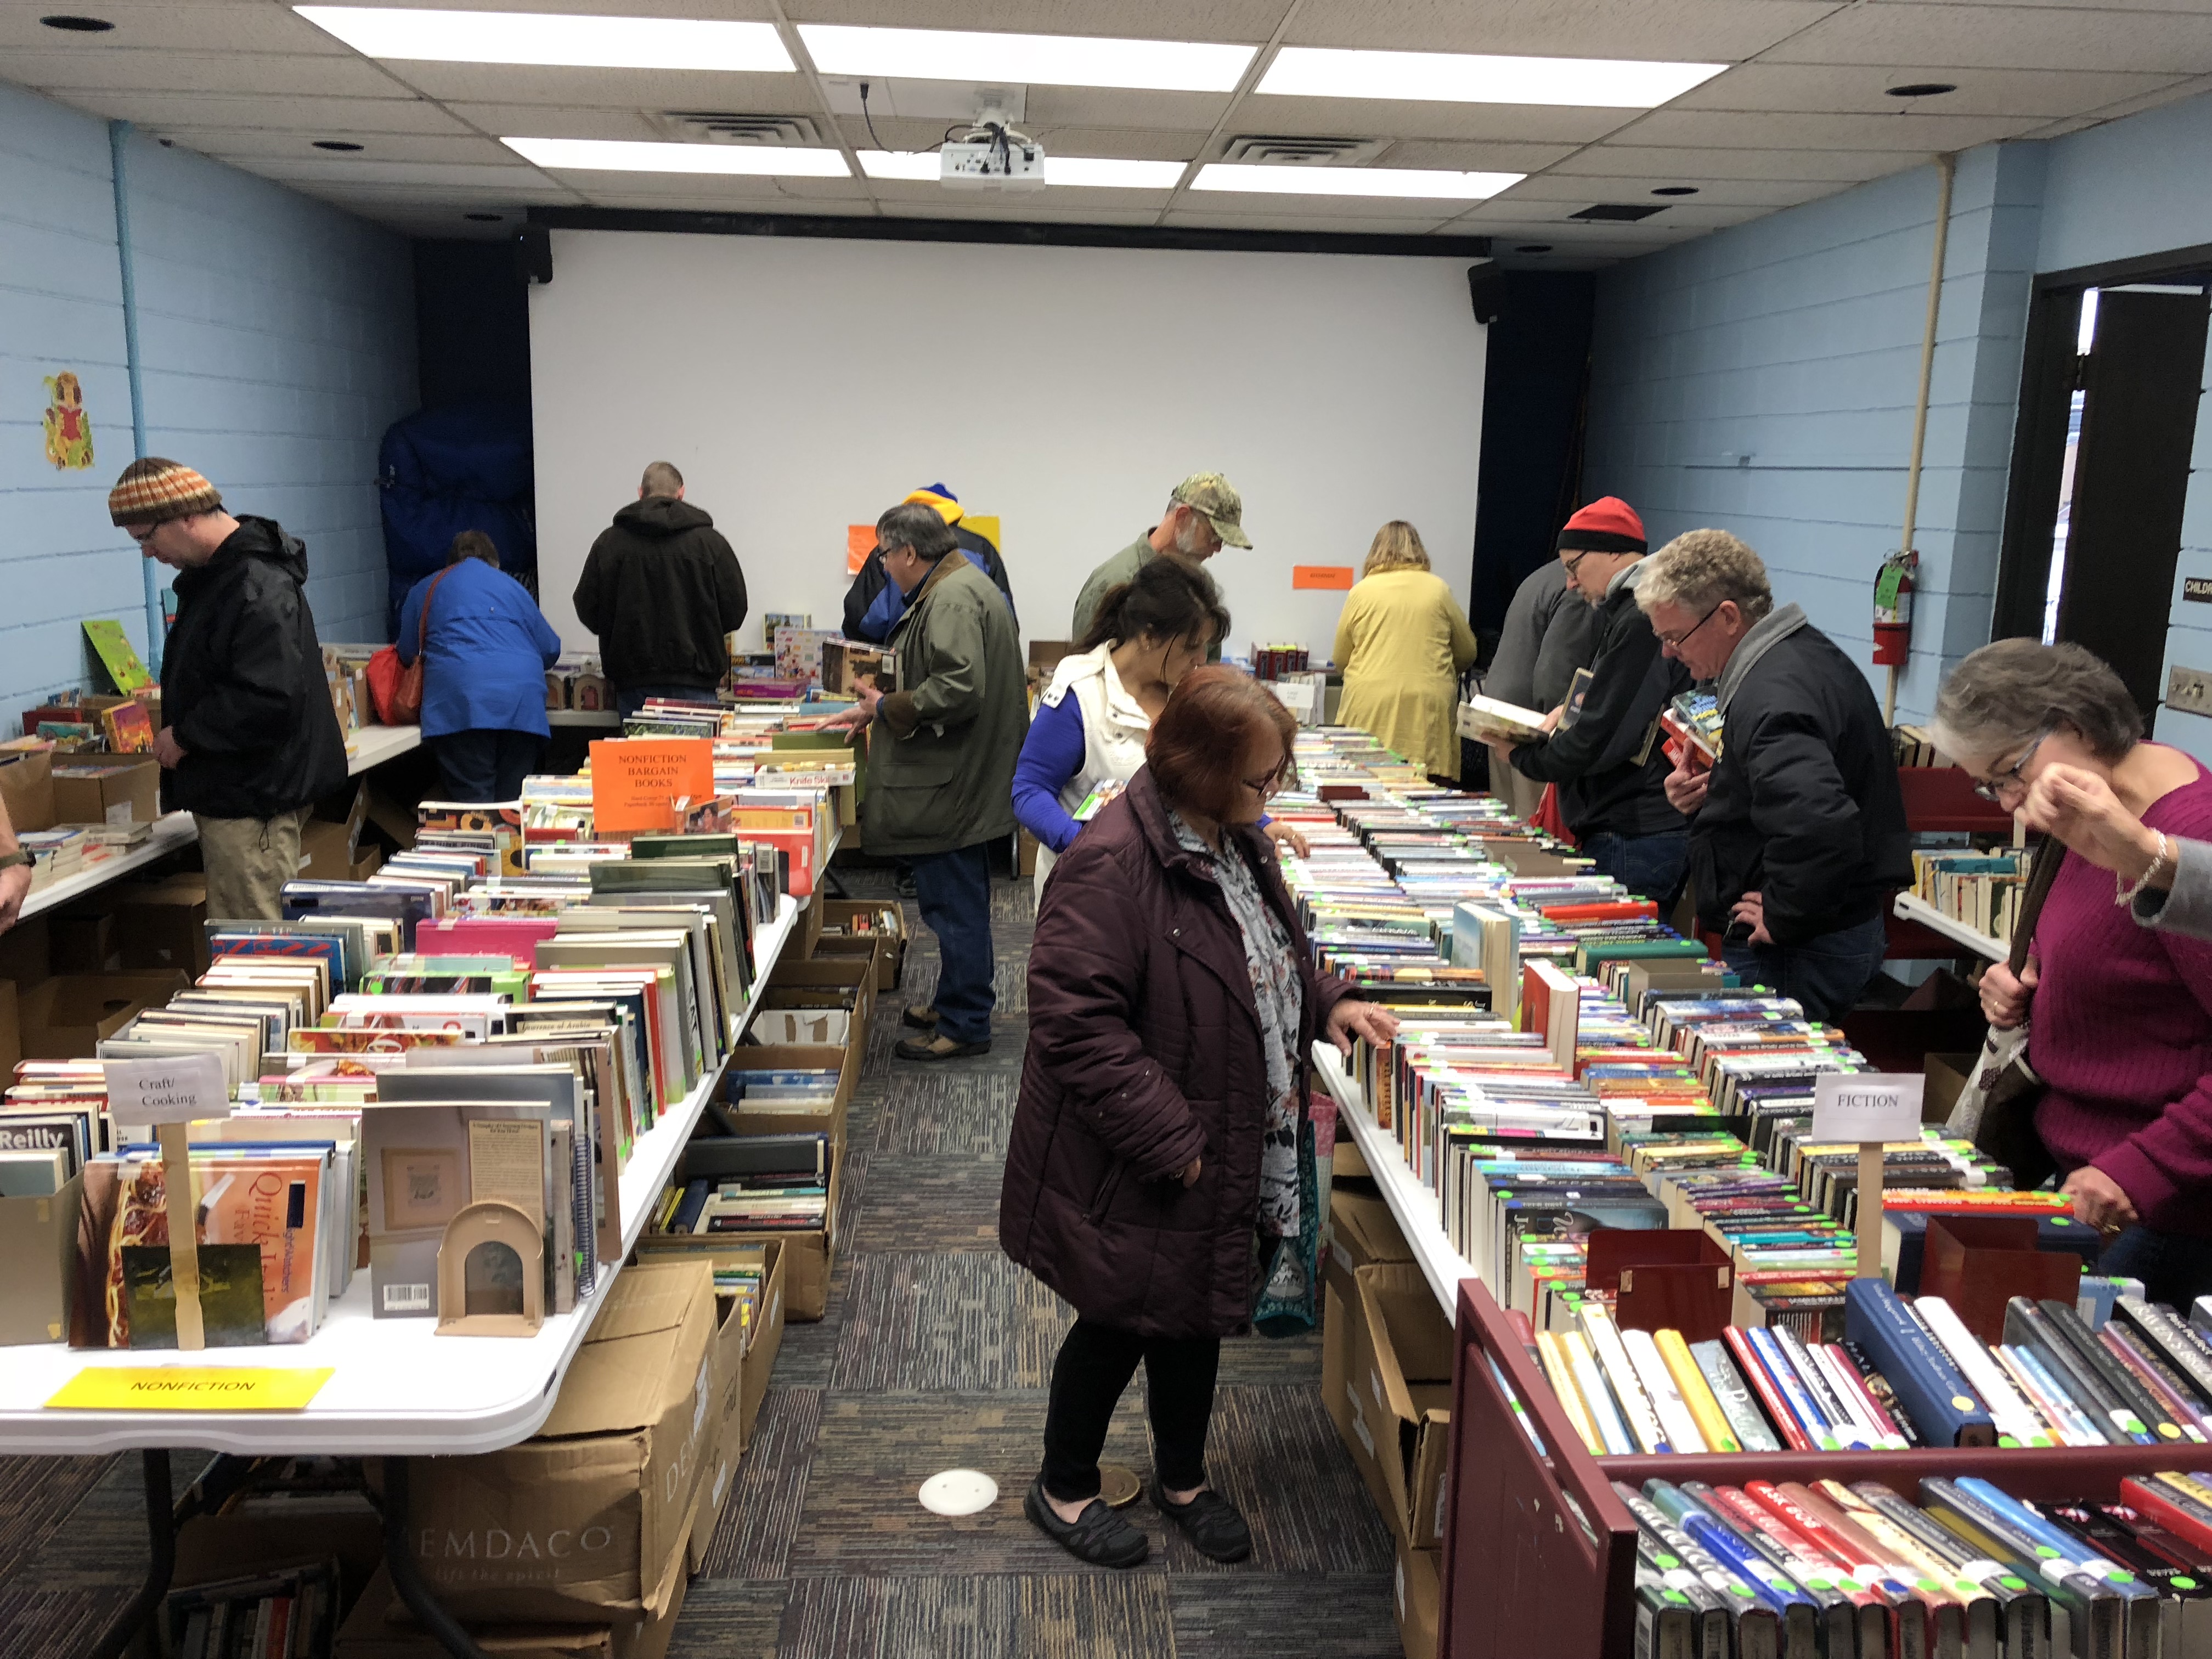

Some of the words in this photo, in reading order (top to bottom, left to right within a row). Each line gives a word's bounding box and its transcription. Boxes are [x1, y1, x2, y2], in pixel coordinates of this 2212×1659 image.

[618, 754, 687, 764] NONFICTION
[628, 766, 679, 776] BARGAIN
[635, 778, 673, 788] BOOKS
[139, 1077, 175, 1091] Craft/
[142, 1093, 197, 1107] Cooking
[1838, 1094, 1899, 1108] FICTION
[131, 1381, 256, 1391] NONFICTION
[420, 1526, 611, 1560] EMDACO
